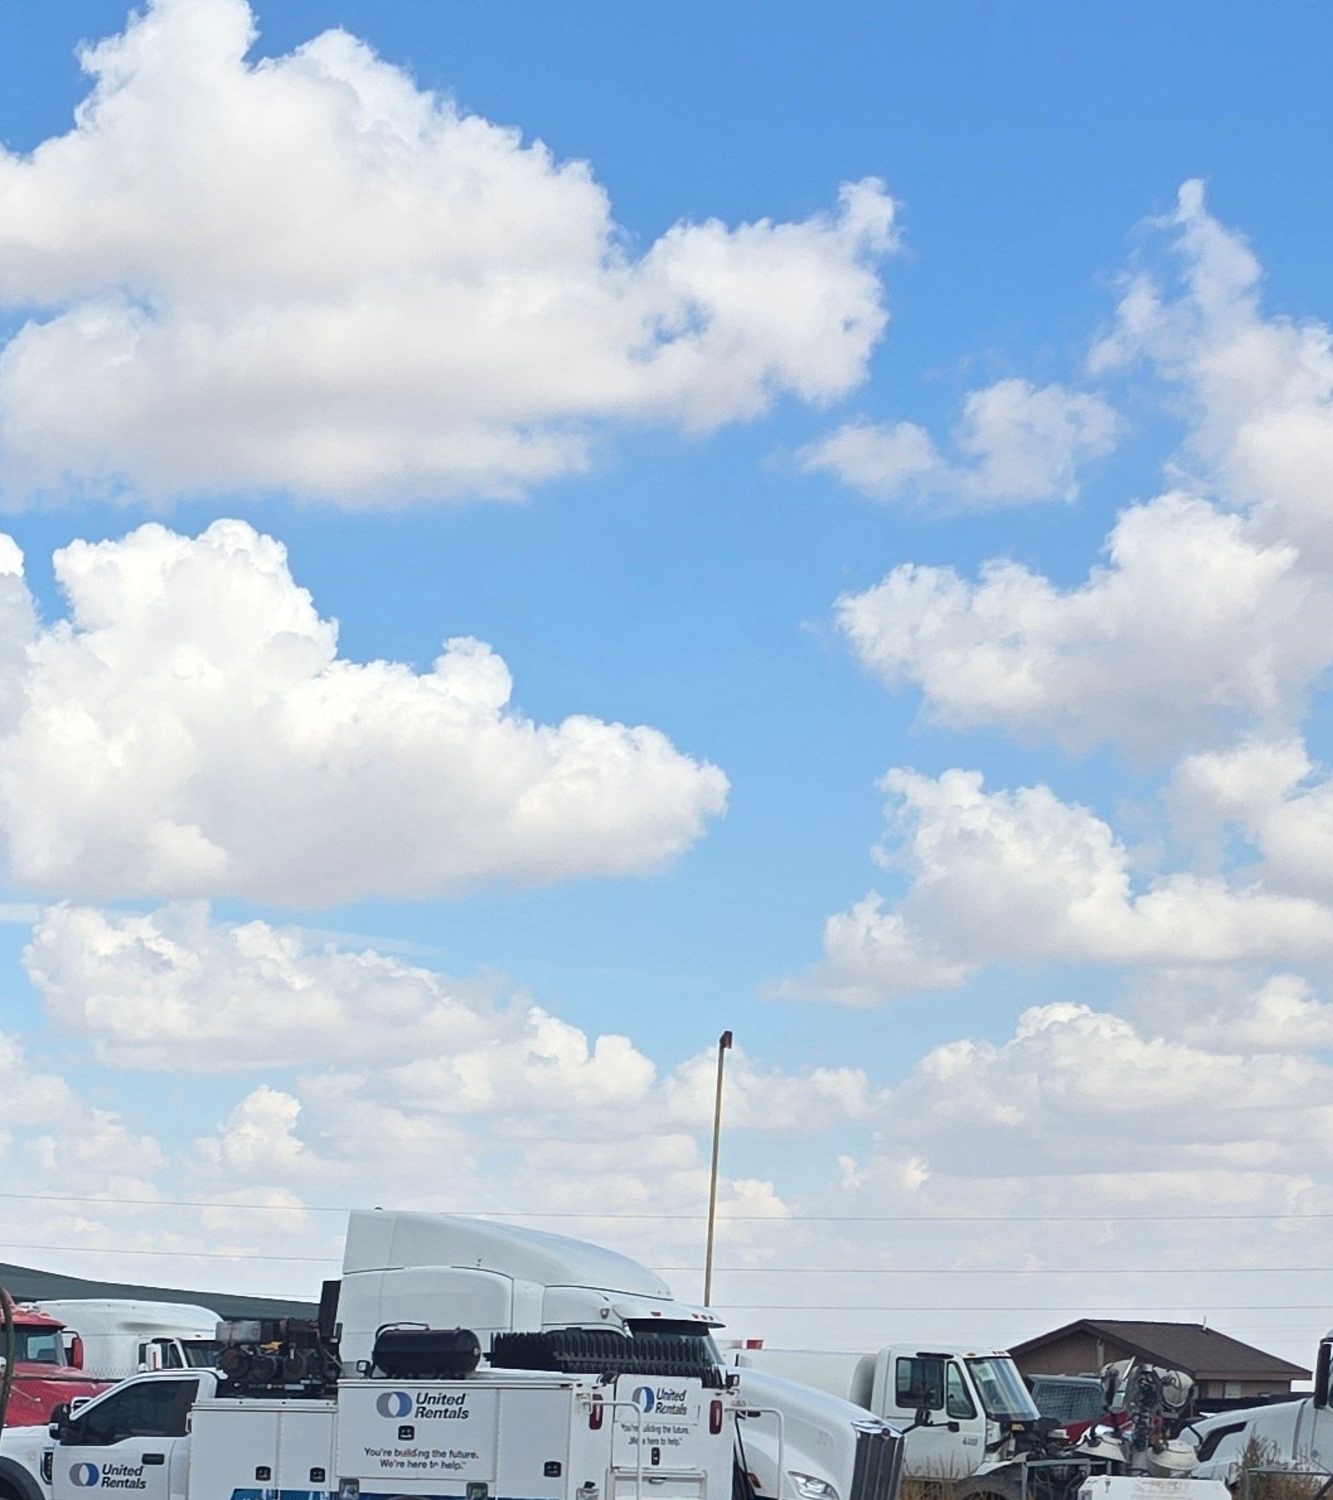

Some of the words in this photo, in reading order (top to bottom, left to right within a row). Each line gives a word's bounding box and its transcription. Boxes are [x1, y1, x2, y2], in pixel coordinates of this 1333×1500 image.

[416, 1392, 467, 1406] United
[656, 1388, 687, 1402] United
[414, 1406, 469, 1419] Rentals
[655, 1402, 688, 1415] Rentals
[364, 1447, 392, 1457] You're
[432, 1449, 447, 1458] the
[101, 1464, 144, 1477] United
[380, 1459, 405, 1469] We're
[407, 1460, 428, 1469] here
[101, 1477, 146, 1489] Rentals
